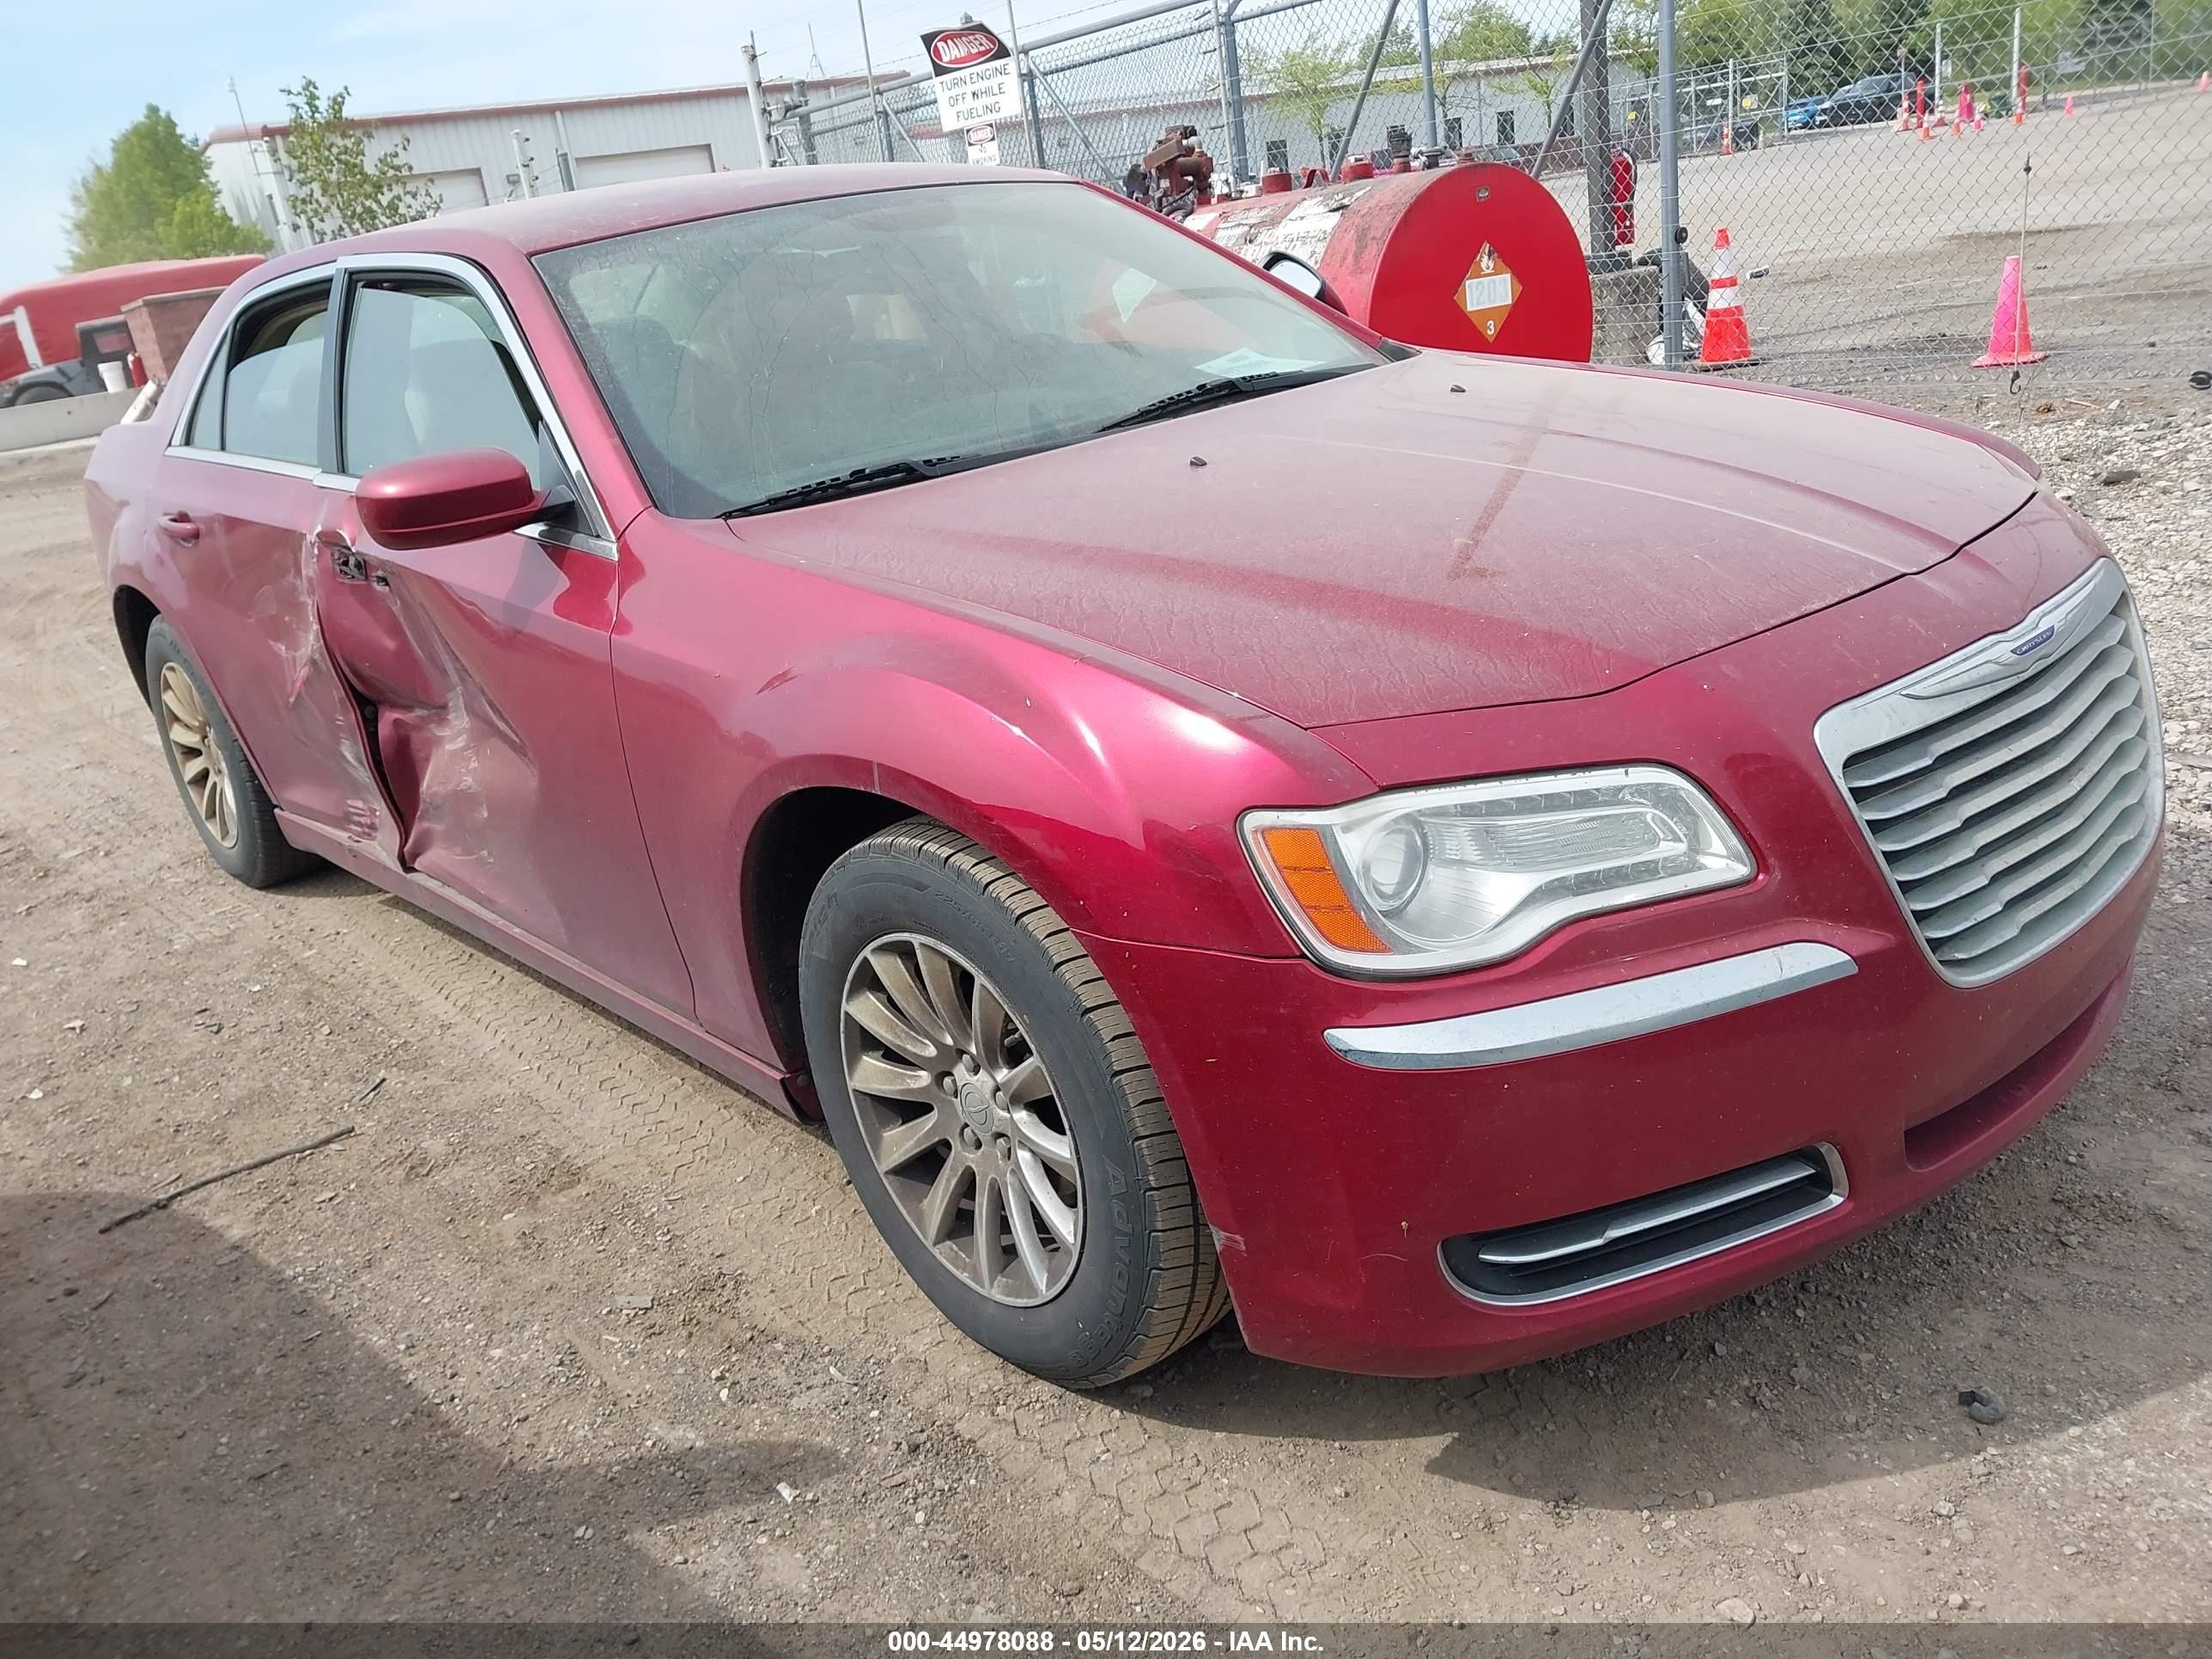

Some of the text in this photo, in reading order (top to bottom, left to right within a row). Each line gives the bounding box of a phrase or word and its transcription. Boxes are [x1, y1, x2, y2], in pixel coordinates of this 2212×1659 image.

[936, 34, 994, 62] DANGER
[939, 64, 1011, 94] TURN ENGINE
[948, 82, 1006, 107] OFF WHILE
[956, 101, 1001, 123] FUELING
[1486, 320, 1495, 335] 3
